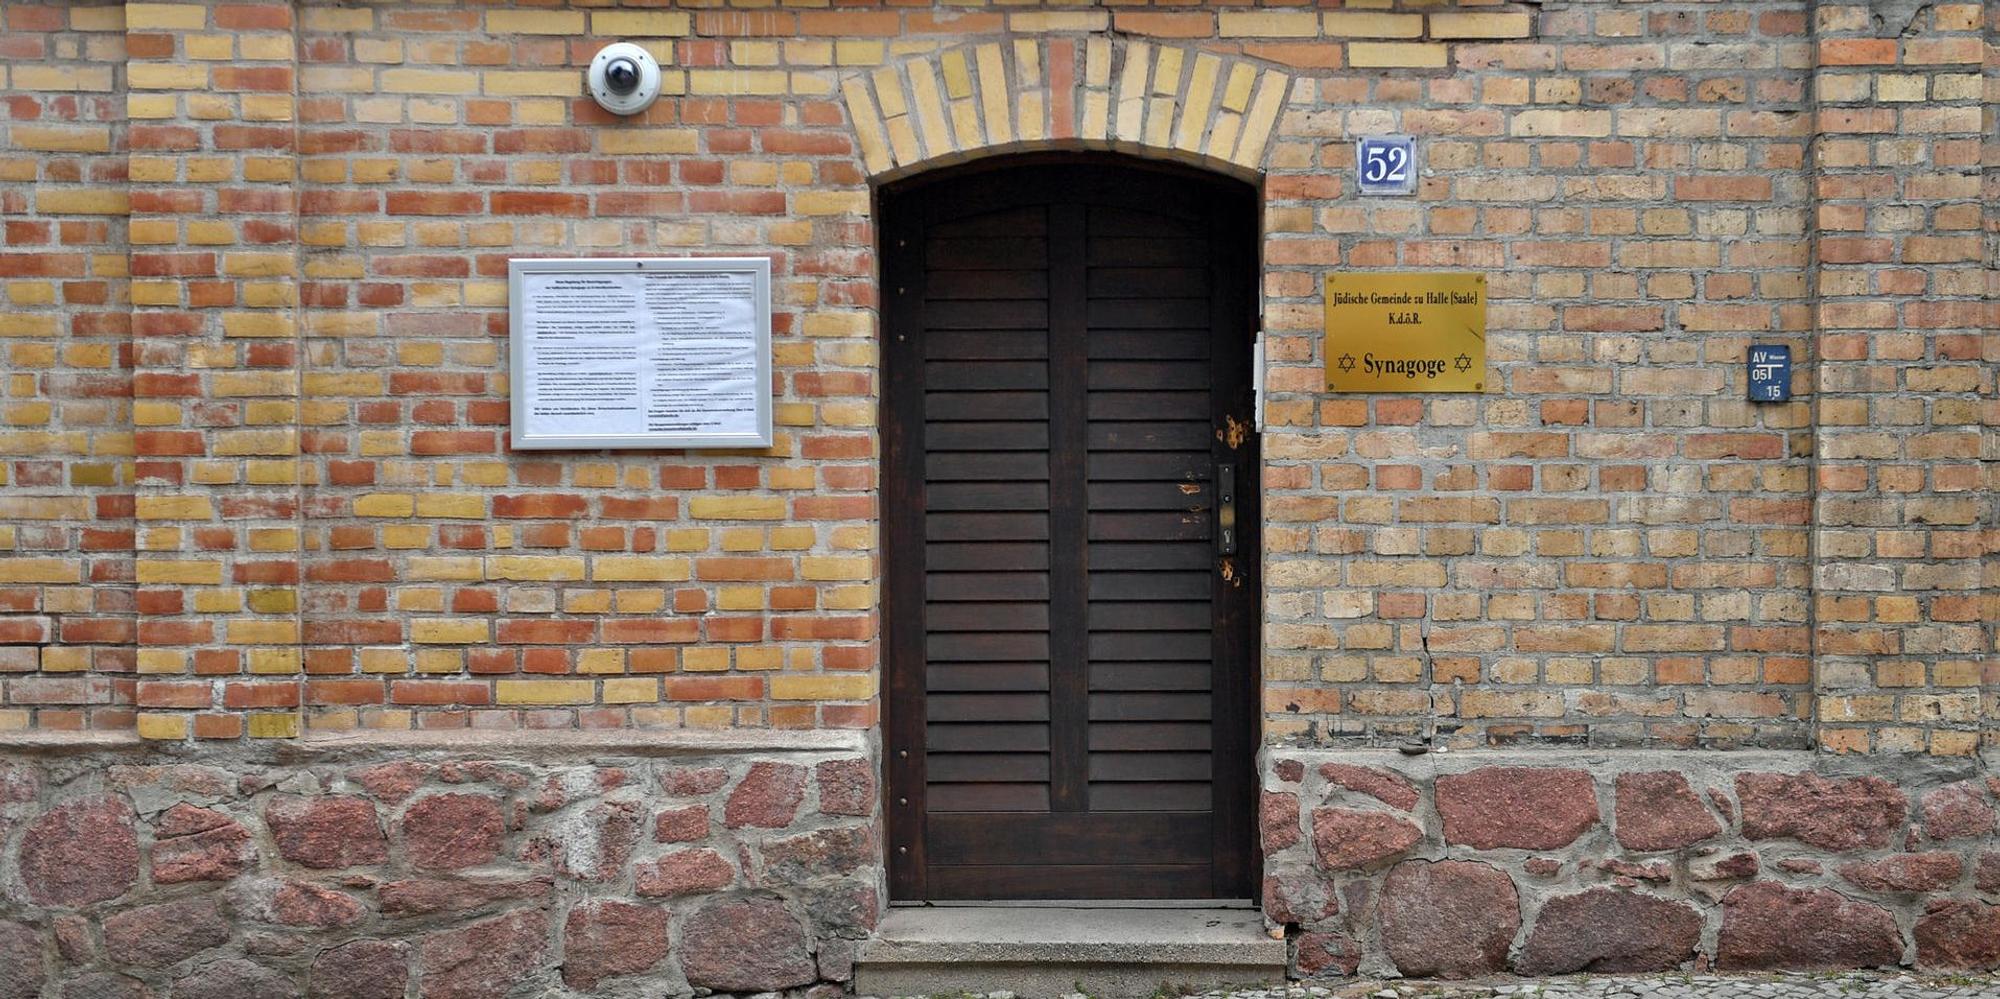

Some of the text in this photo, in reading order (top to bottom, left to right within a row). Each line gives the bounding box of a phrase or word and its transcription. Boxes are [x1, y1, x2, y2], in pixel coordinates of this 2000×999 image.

[1366, 147, 1407, 182] 52
[1333, 291, 1478, 306] Jüdische Gemeinde zu Halle (Saale)
[1752, 352, 1767, 363] AV
[1364, 352, 1446, 379] Synagoge
[1752, 369, 1767, 381] 05
[1766, 385, 1781, 397] 15
